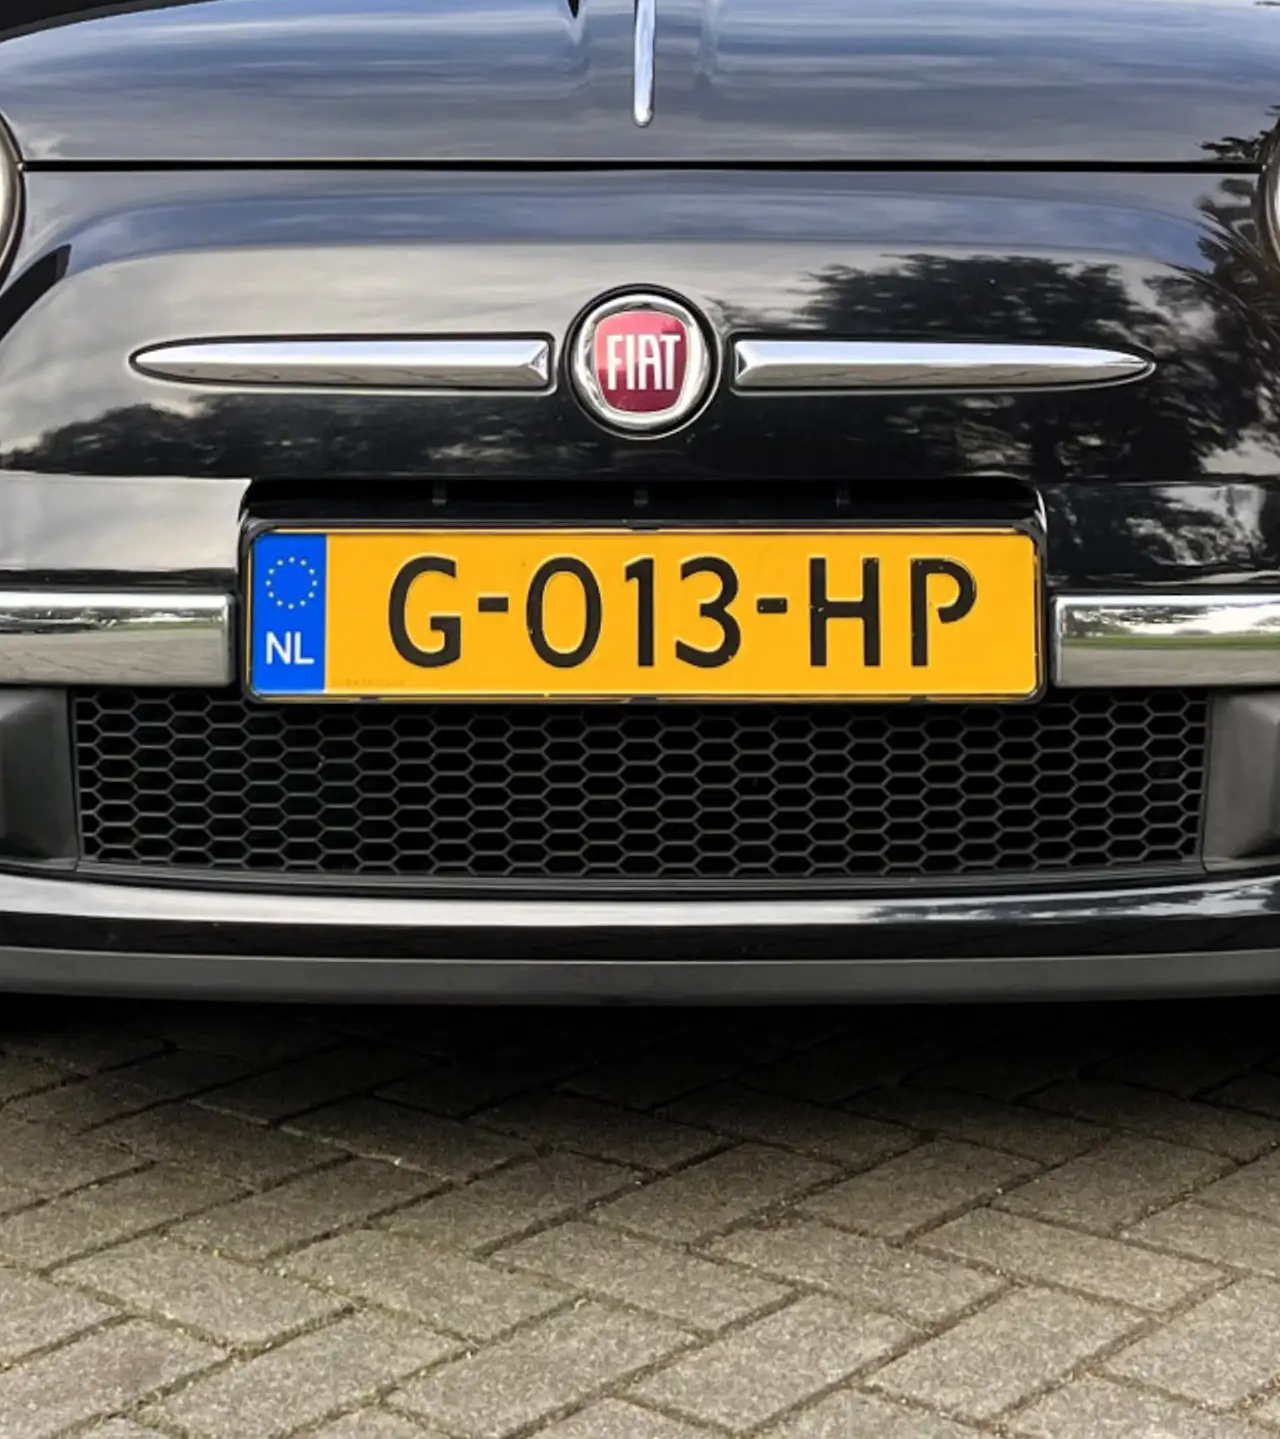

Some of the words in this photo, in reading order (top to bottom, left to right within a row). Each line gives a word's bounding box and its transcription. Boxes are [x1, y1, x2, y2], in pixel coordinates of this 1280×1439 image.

[606, 334, 681, 391] FIAT
[387, 555, 978, 669] G-013-HP
[265, 633, 314, 665] NL
